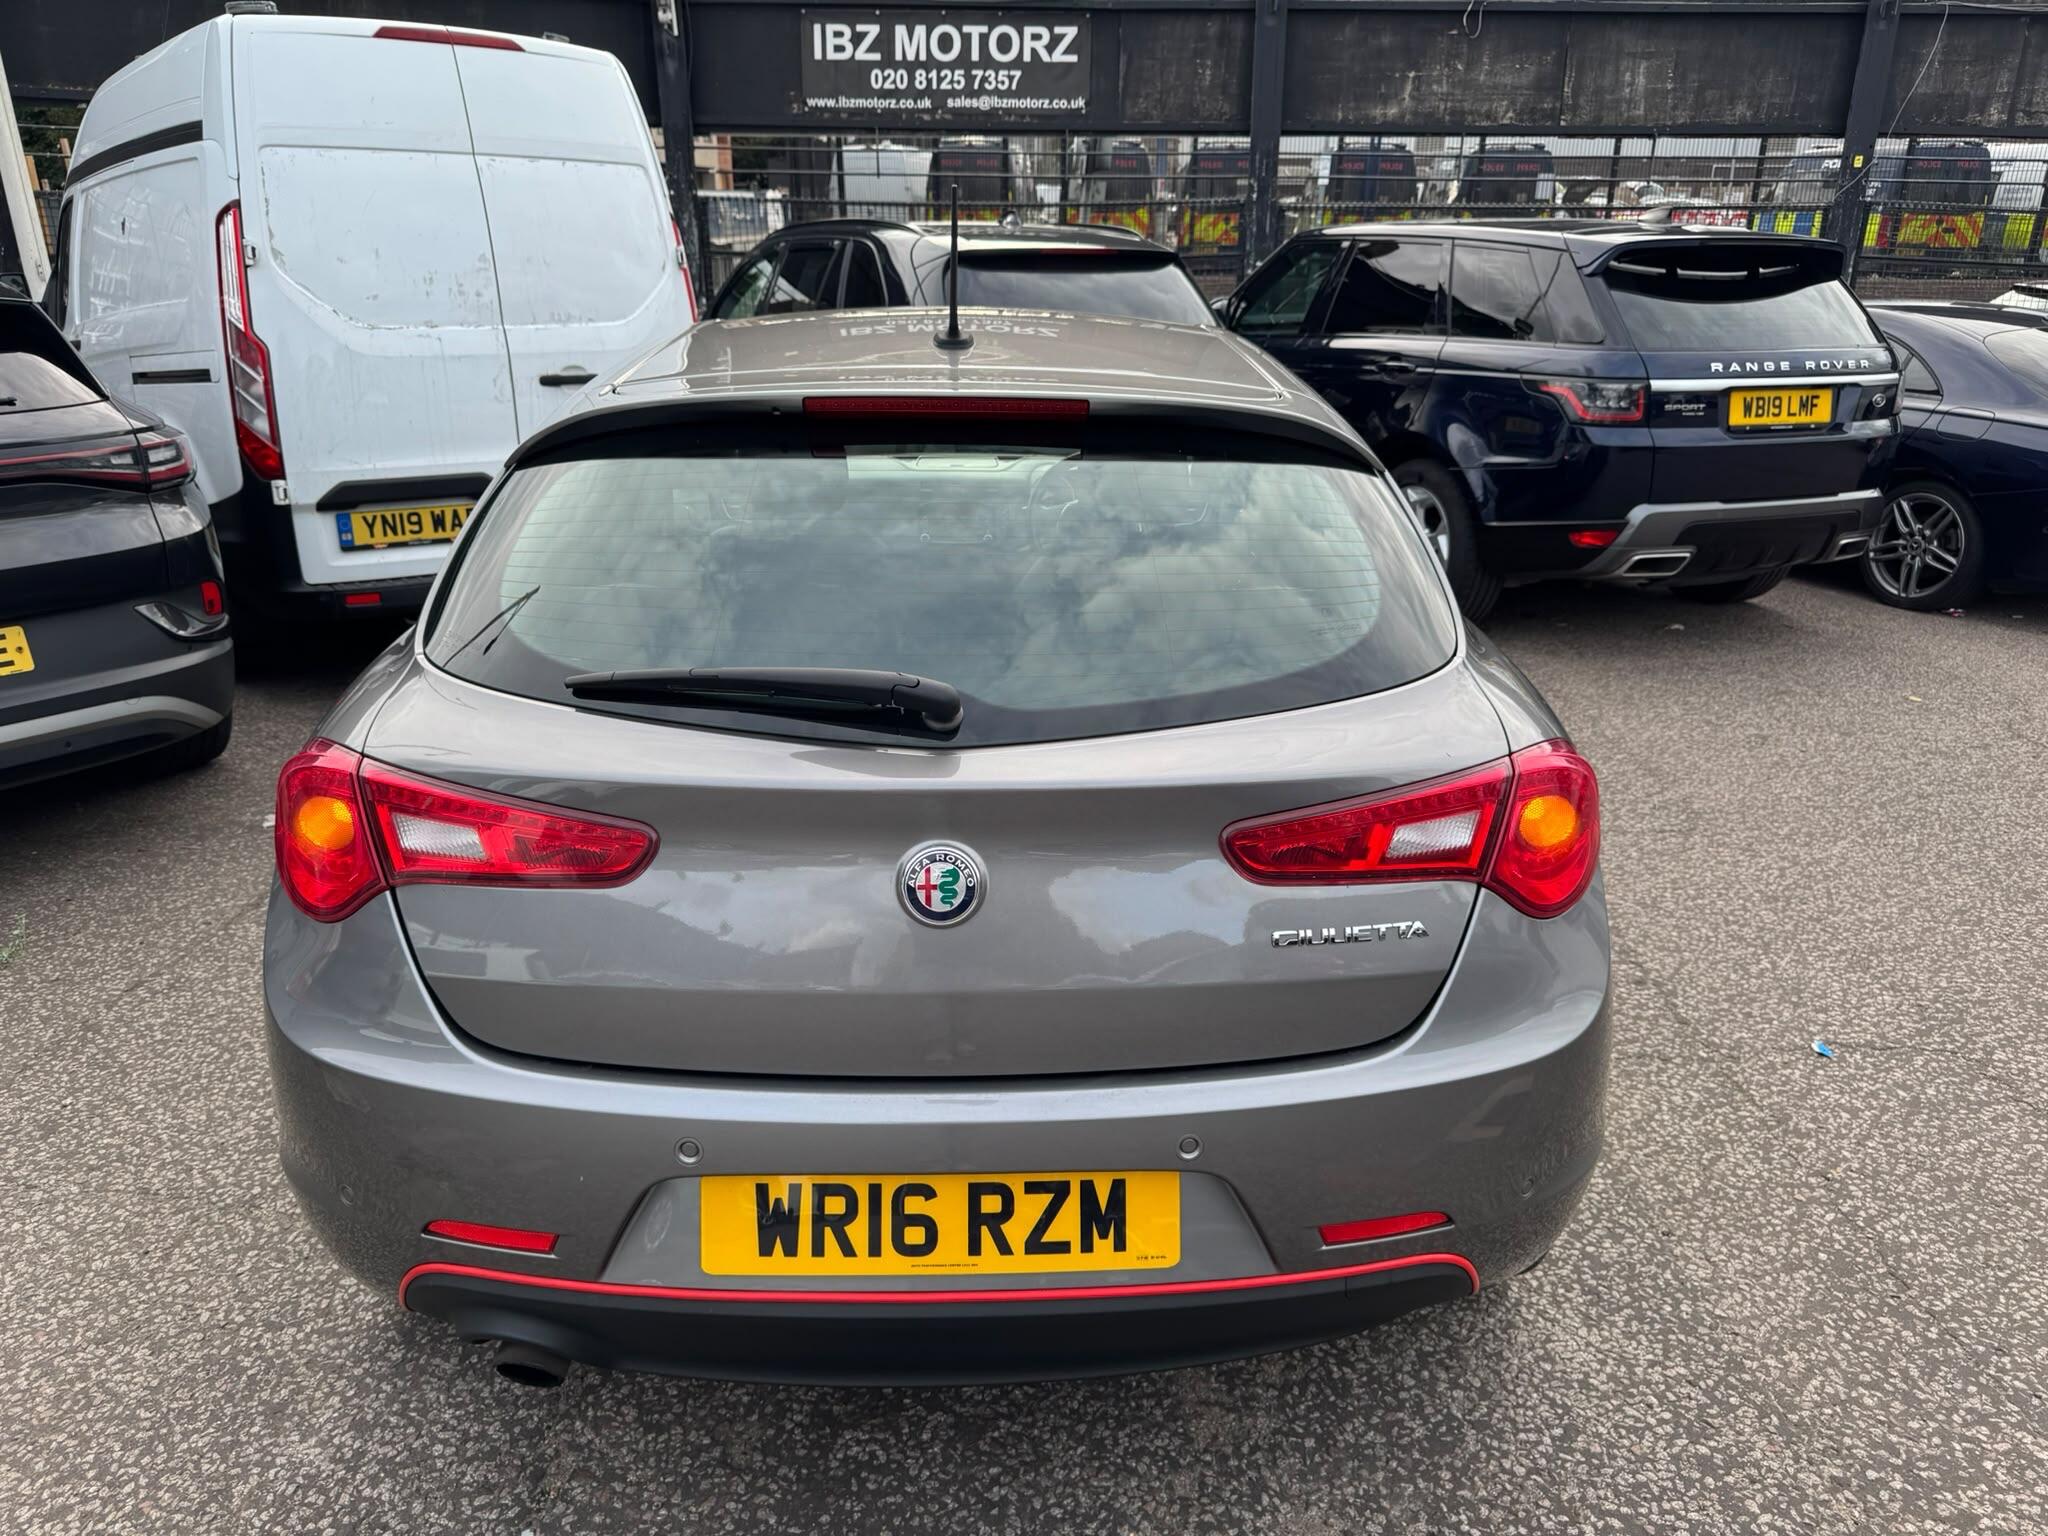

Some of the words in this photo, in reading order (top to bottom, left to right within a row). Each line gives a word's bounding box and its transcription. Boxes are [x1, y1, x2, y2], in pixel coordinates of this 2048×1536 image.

[813, 23, 882, 61] IBZ
[894, 24, 1079, 63] MOTORZ
[870, 69, 908, 90] 020
[914, 68, 966, 91] 8125
[971, 69, 1022, 91] 7357
[806, 96, 932, 110] www.ibzmotorz.co.uk
[947, 96, 1086, 111] sales@ibzmotorz.co.uk
[1711, 361, 1791, 373] RANGE
[1805, 359, 1869, 370] ROVER
[1664, 403, 1707, 412] SPORT
[1743, 395, 1783, 419] WB19
[1786, 394, 1820, 418] LMF
[361, 511, 423, 539] YN19
[906, 858, 930, 888] ALFA
[935, 853, 975, 887] ROMEO
[1271, 920, 1430, 949] GIULIETTA
[754, 1182, 939, 1259] WR16
[967, 1178, 1128, 1257] RZM
